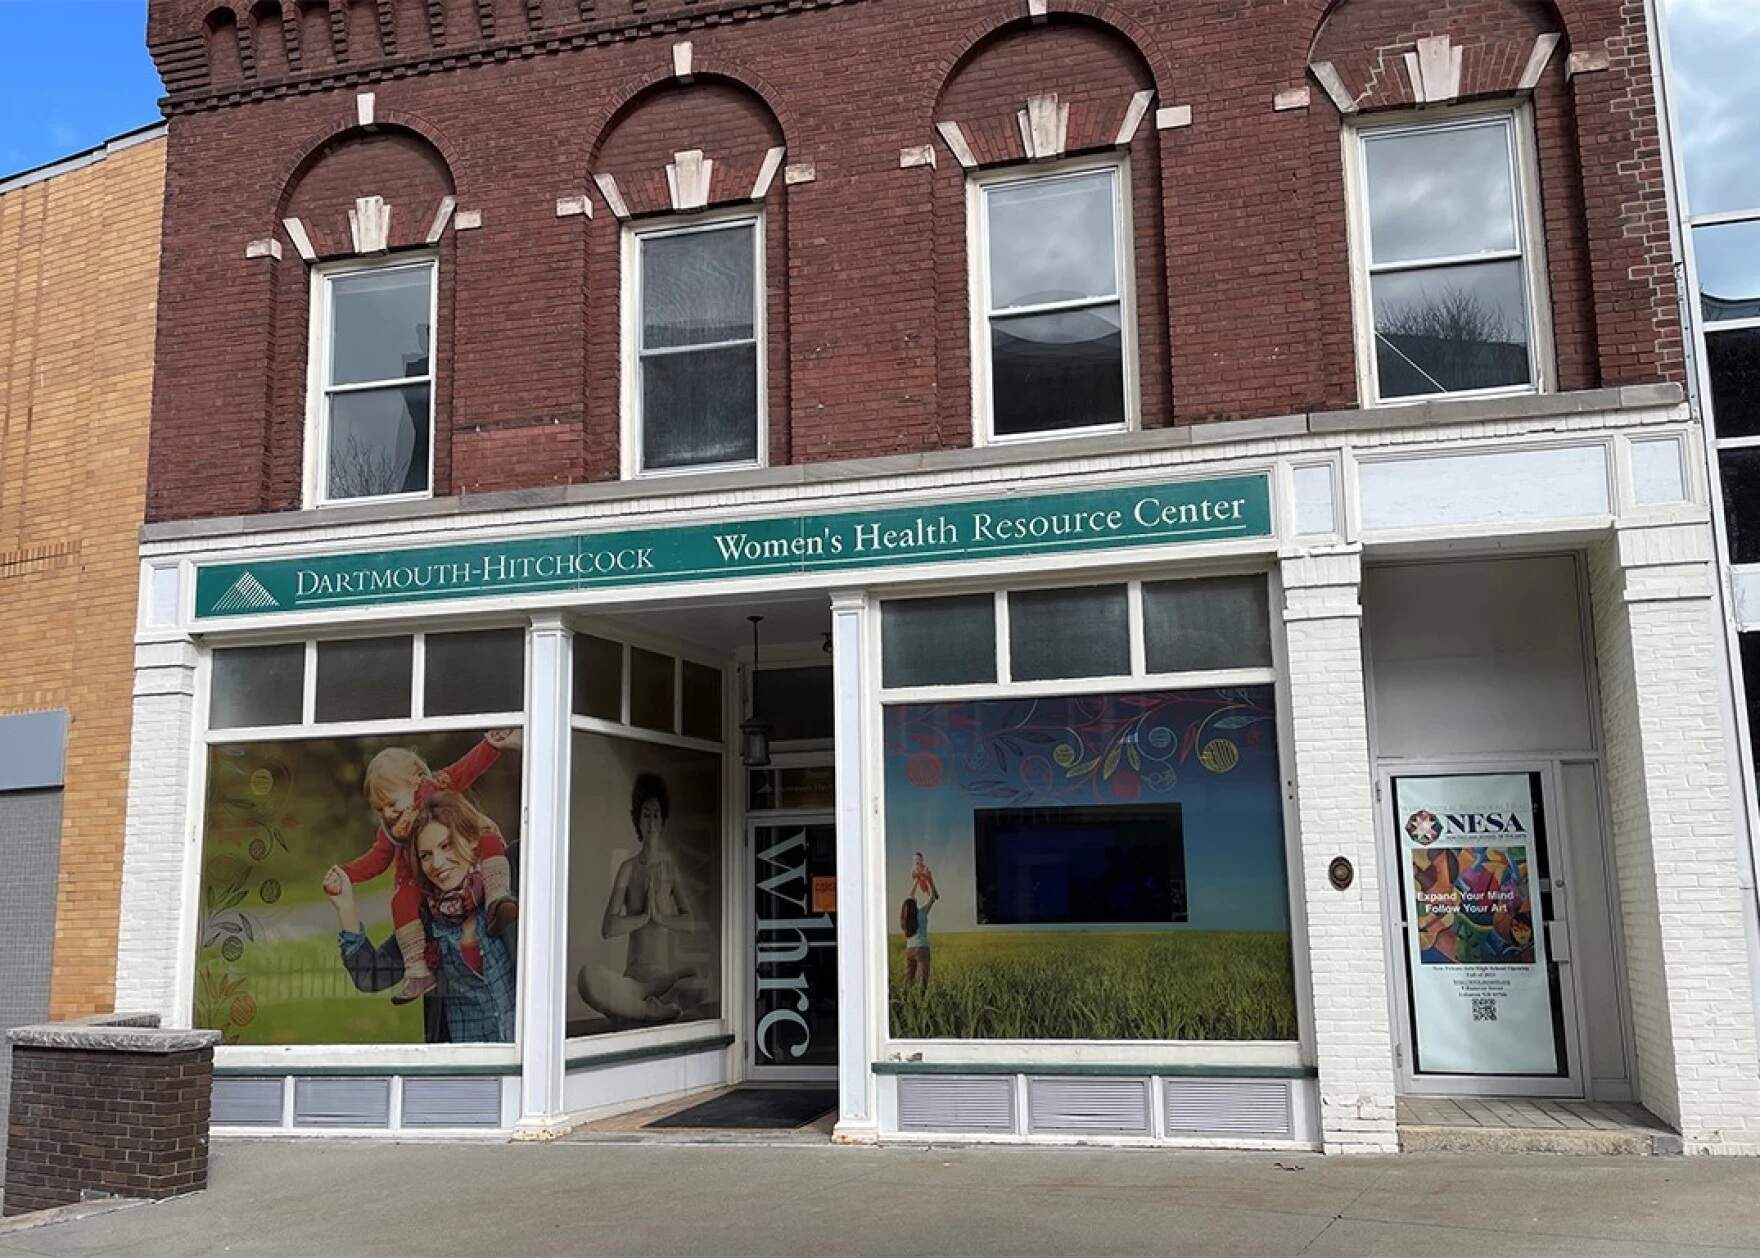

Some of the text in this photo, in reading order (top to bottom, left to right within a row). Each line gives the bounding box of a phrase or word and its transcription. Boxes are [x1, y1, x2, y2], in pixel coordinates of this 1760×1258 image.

[714, 497, 1246, 561] Women's Health Resource Center
[296, 547, 655, 596] DARTMOUTH-HITCHCOCK
[1445, 812, 1526, 833] NESA
[1417, 890, 1514, 902] Expand Your Mind
[1425, 903, 1508, 913] Follow Your Art
[755, 826, 835, 1060] whrc
